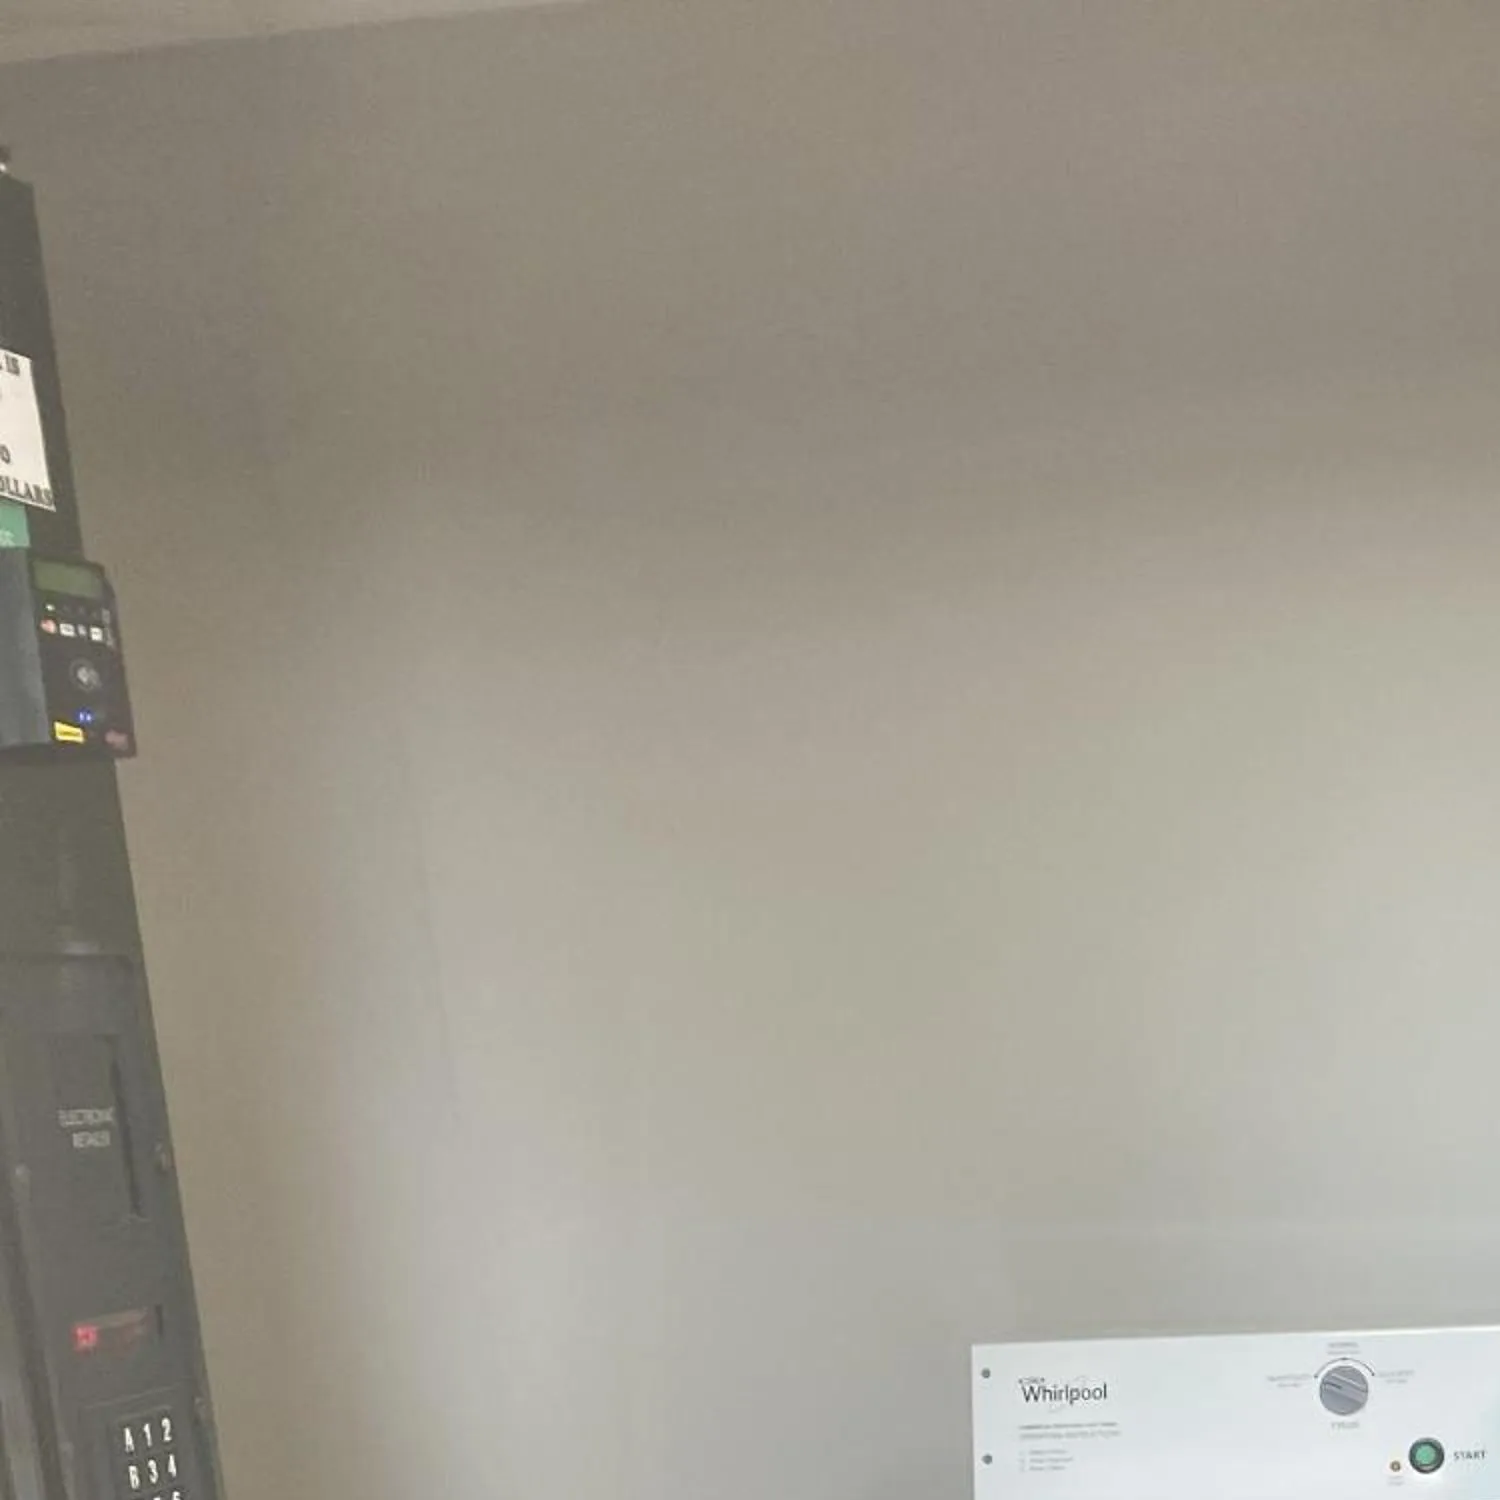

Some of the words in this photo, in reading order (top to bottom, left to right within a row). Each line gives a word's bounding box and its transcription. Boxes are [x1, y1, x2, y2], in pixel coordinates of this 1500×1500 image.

[1020, 1381, 1108, 1406] Whirlpool
[124, 1427, 135, 1453] A
[143, 1422, 153, 1447] 1
[161, 1417, 172, 1442] 2
[1453, 1449, 1486, 1461] START
[128, 1465, 140, 1490] B
[147, 1459, 159, 1484] 3
[167, 1453, 177, 1478] 4
